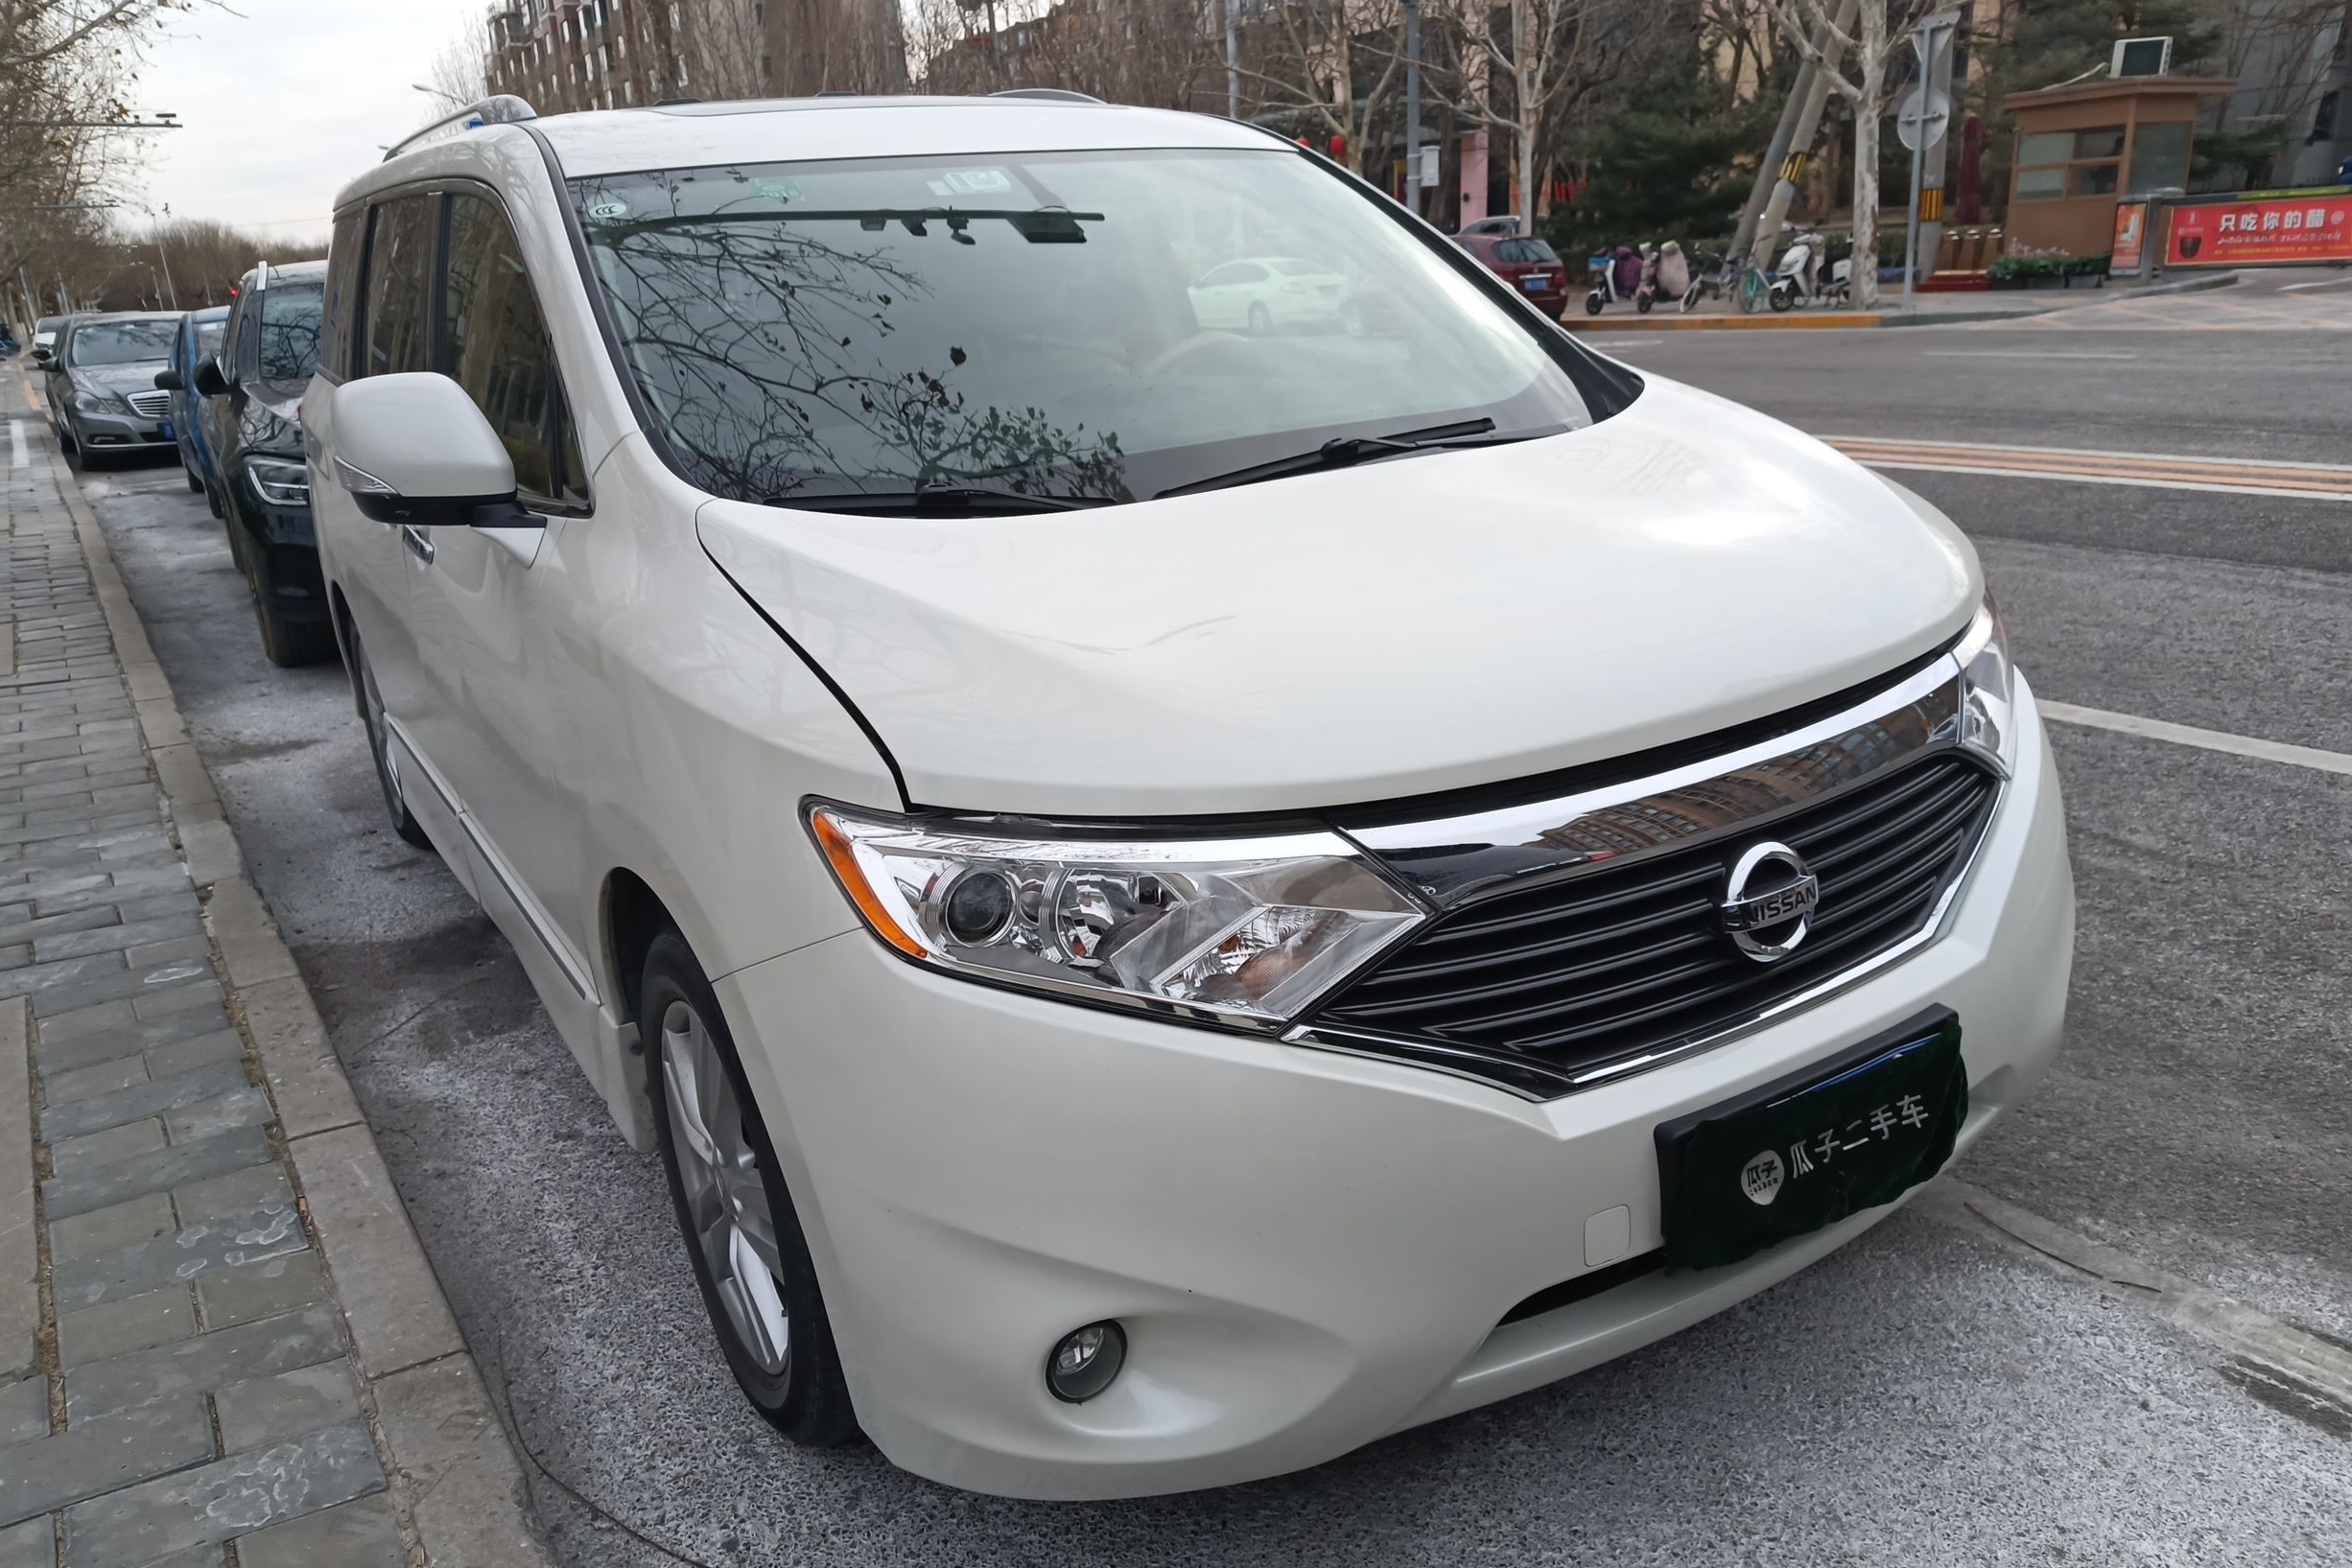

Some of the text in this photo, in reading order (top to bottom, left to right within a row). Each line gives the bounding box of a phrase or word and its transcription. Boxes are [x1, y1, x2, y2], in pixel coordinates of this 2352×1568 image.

[1790, 1094, 1929, 1179] 瓜子二手车
[1747, 1159, 1777, 1188] 瓜子
